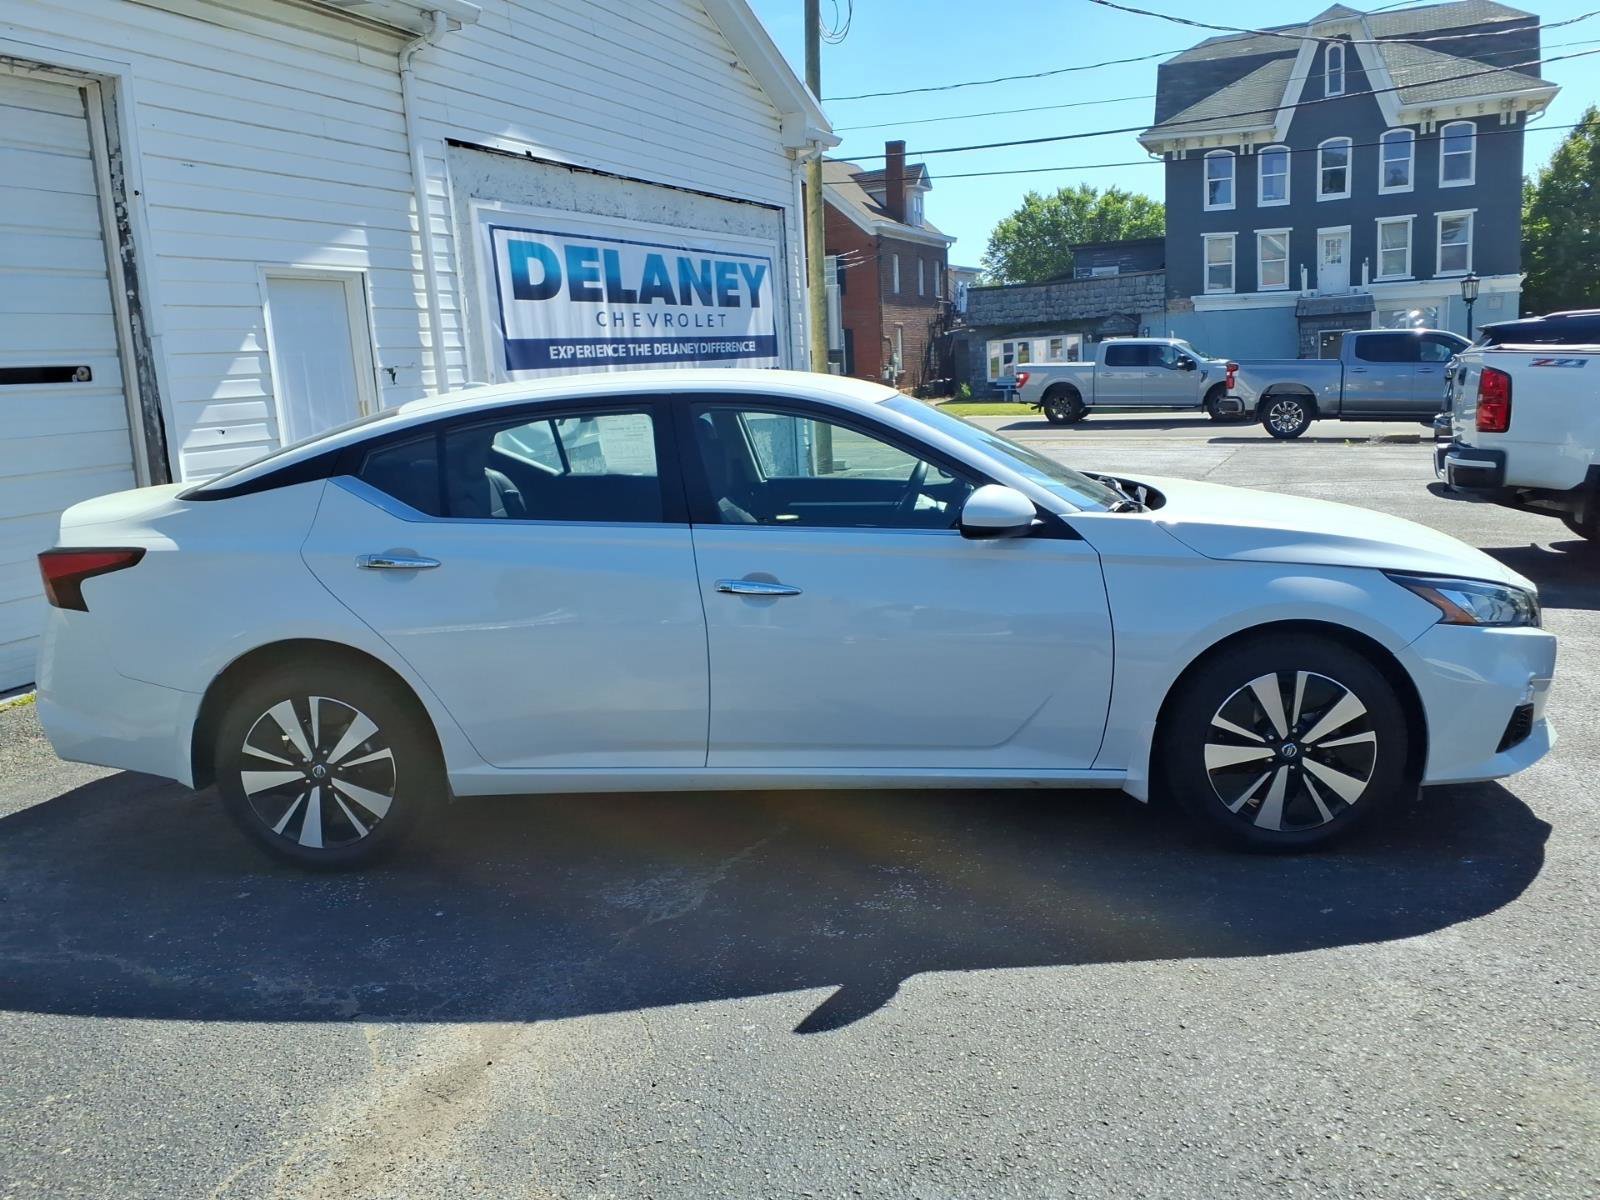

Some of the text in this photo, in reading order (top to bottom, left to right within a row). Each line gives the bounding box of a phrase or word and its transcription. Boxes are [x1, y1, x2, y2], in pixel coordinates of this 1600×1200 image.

[507, 238, 766, 308] DELANEY
[596, 311, 726, 328] CHEVROLET
[549, 344, 627, 360] EXPERIENCE
[628, 343, 652, 357] THE
[653, 342, 700, 356] DELANEY
